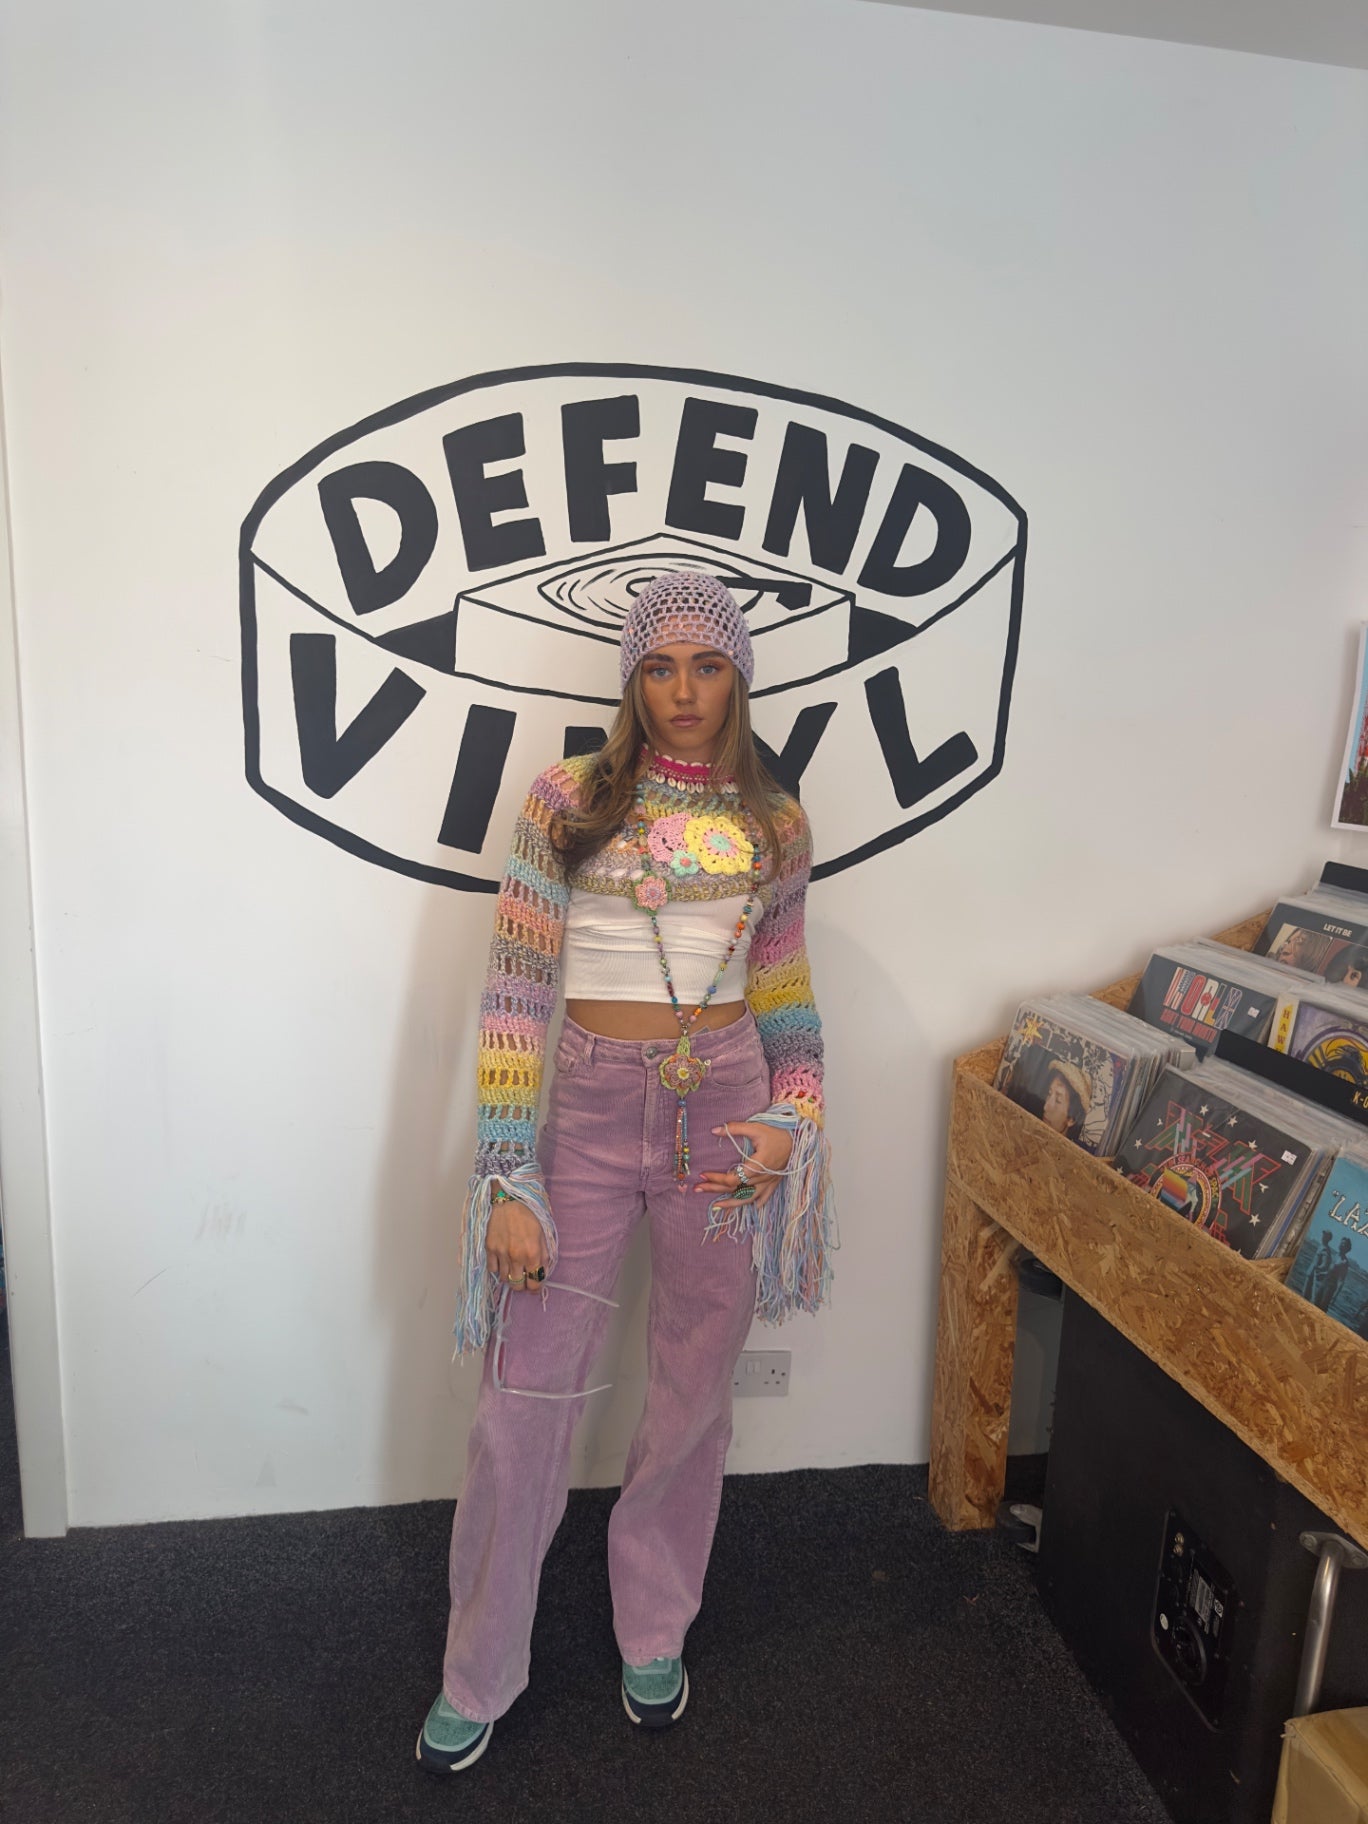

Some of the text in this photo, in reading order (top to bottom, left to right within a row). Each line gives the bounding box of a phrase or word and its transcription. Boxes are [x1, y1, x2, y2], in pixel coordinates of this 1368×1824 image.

[318, 394, 971, 614] DEFEND
[289, 633, 978, 855] VIYL
[1323, 923, 1353, 938] LET IT BE
